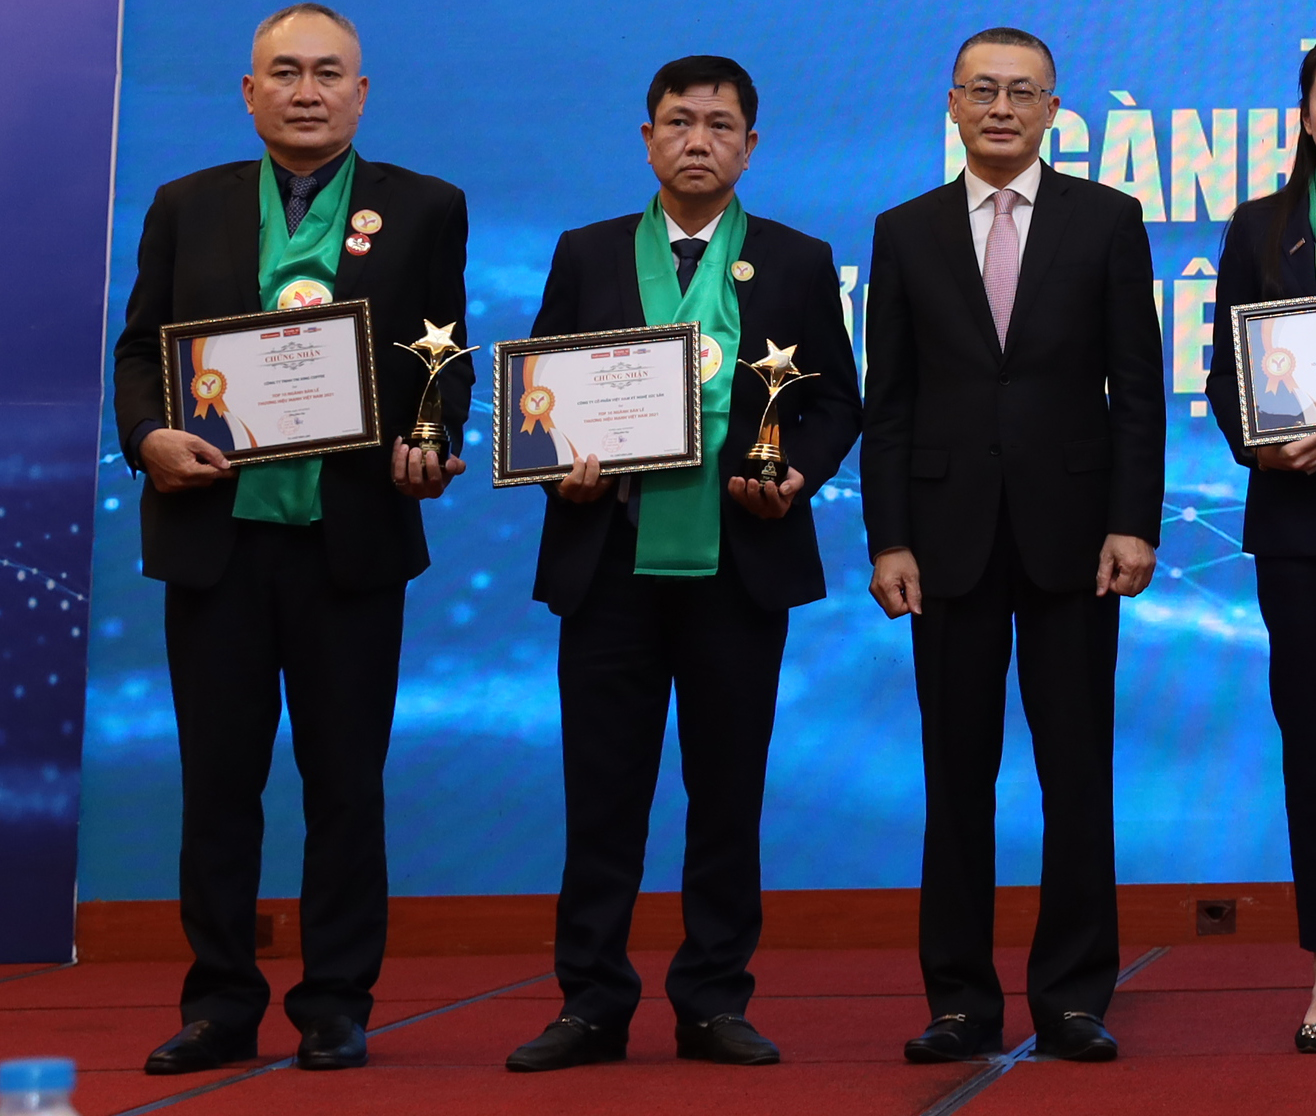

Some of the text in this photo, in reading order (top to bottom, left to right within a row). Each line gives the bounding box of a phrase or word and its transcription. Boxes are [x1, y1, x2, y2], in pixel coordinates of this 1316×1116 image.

[264, 349, 321, 363] CHỨNG NHẬN
[594, 370, 649, 382] CHỨNG NHẬN
